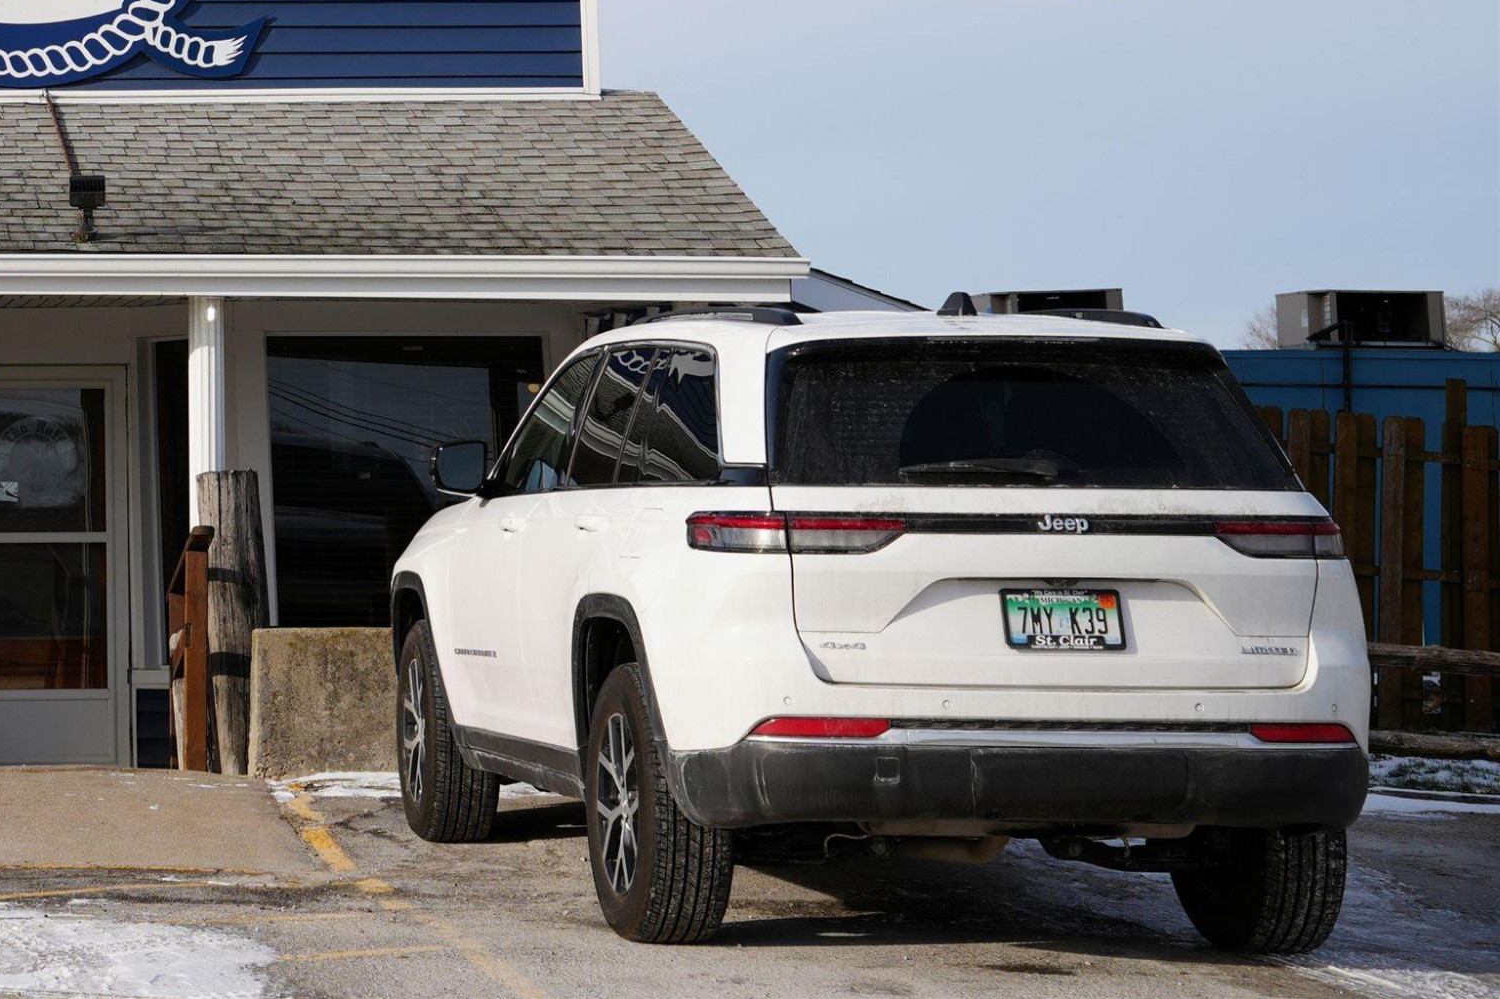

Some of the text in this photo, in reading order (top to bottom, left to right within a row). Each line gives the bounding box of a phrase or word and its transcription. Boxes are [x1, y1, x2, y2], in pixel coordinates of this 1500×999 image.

[1037, 514, 1089, 534] Jeep
[1040, 596, 1083, 604] MICHIGAN
[1017, 606, 1109, 635] 7MY K39
[1035, 635, 1098, 646] St. Clair
